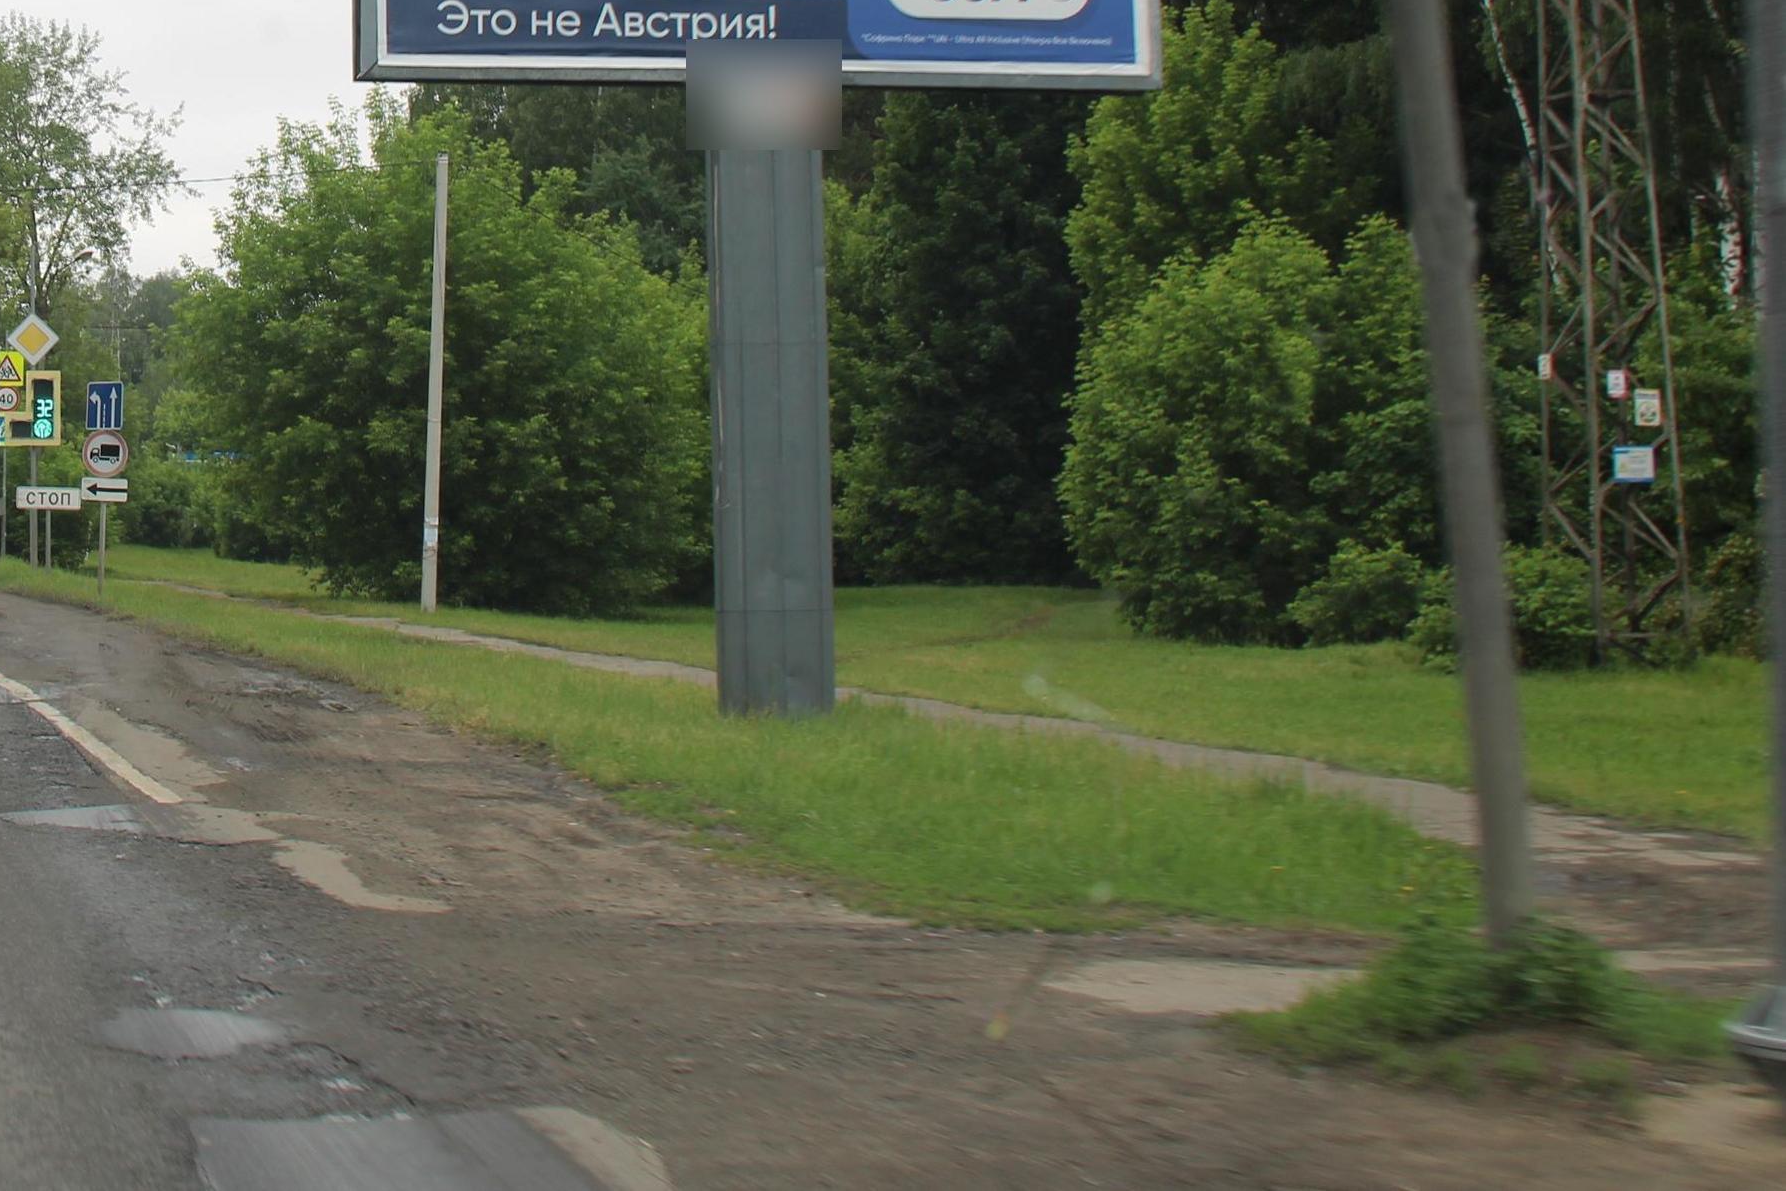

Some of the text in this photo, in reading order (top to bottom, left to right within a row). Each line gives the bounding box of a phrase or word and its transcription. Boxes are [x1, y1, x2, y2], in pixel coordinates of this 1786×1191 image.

[437, 0, 778, 40] Это не Австрия!
[36, 398, 53, 418] 32
[26, 491, 71, 506] СТОП
